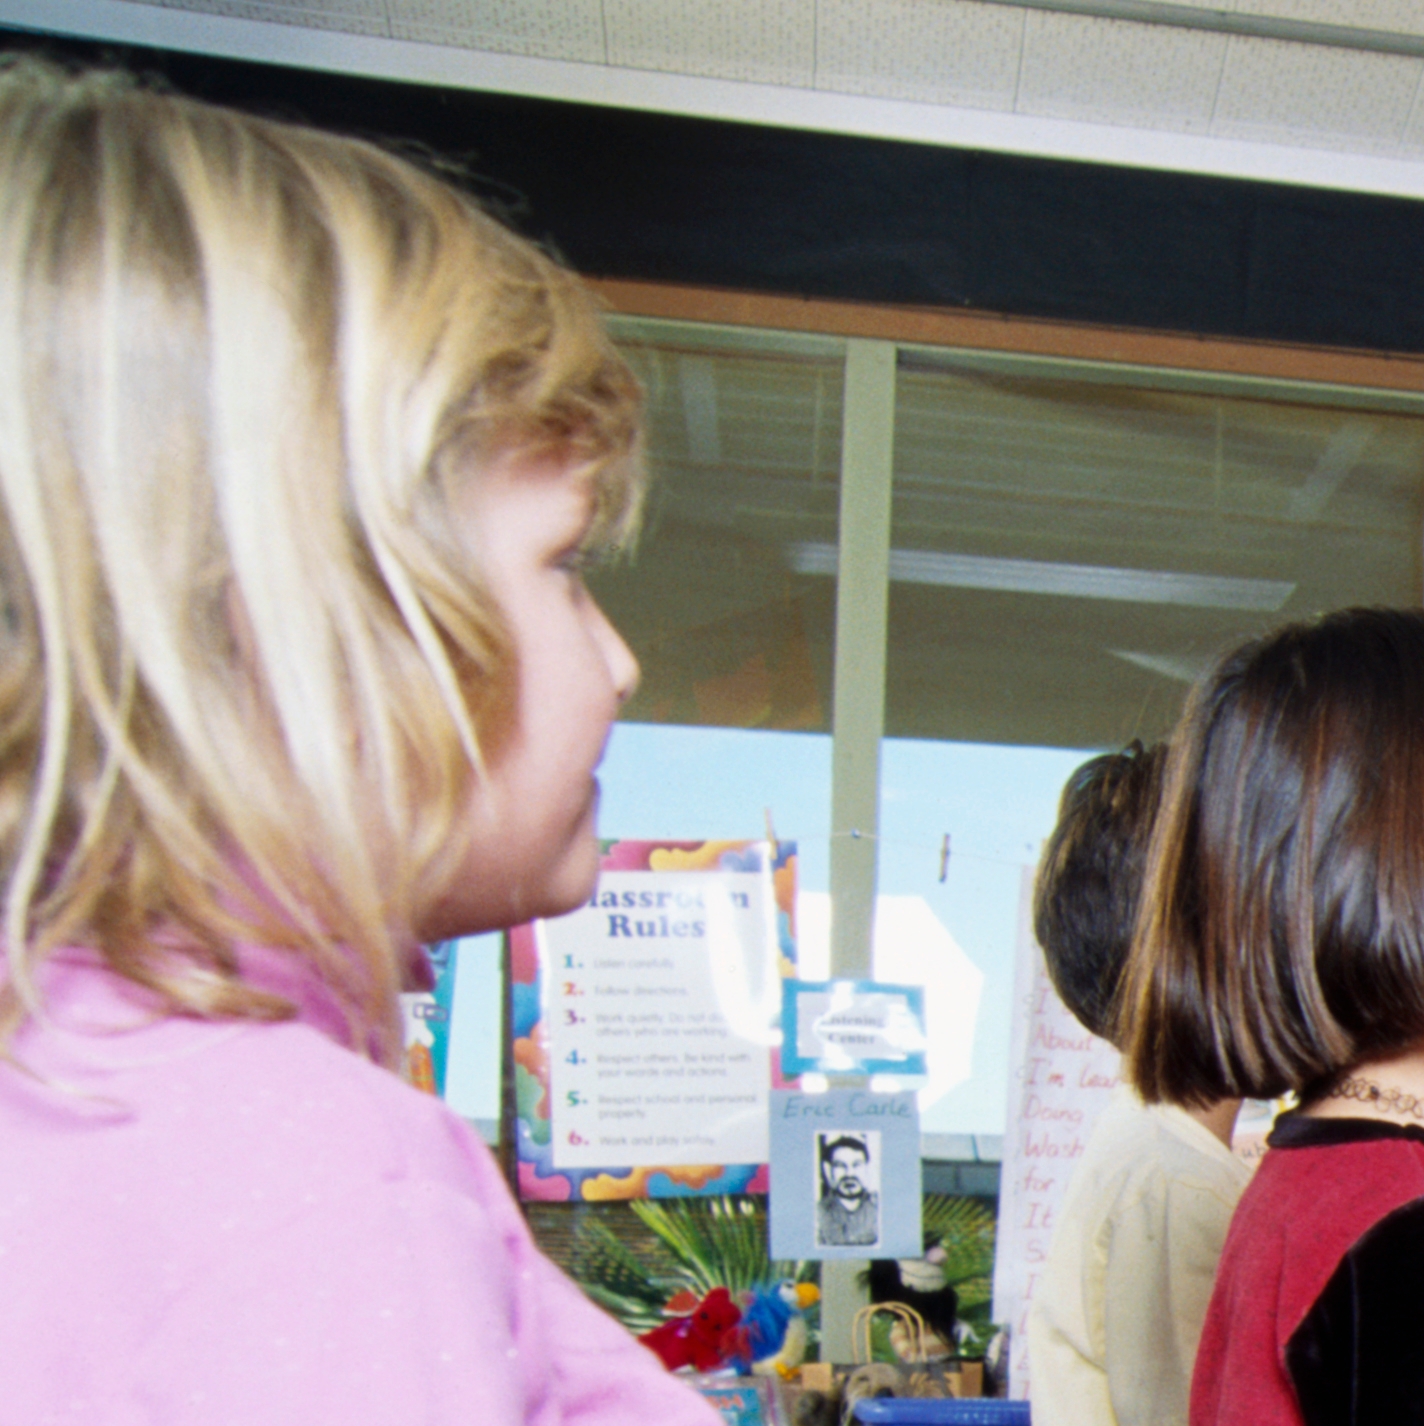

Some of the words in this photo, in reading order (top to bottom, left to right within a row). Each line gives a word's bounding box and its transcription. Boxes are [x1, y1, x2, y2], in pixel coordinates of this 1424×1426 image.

[606, 913, 706, 939] Rules
[563, 953, 584, 969] 1.
[563, 981, 585, 996] 2.
[564, 1008, 587, 1026] 3.
[564, 1048, 588, 1066] 4.
[566, 1090, 589, 1108] 5.
[783, 1094, 836, 1119] Eric
[849, 1092, 914, 1119] Carle
[567, 1129, 590, 1146] 6.
